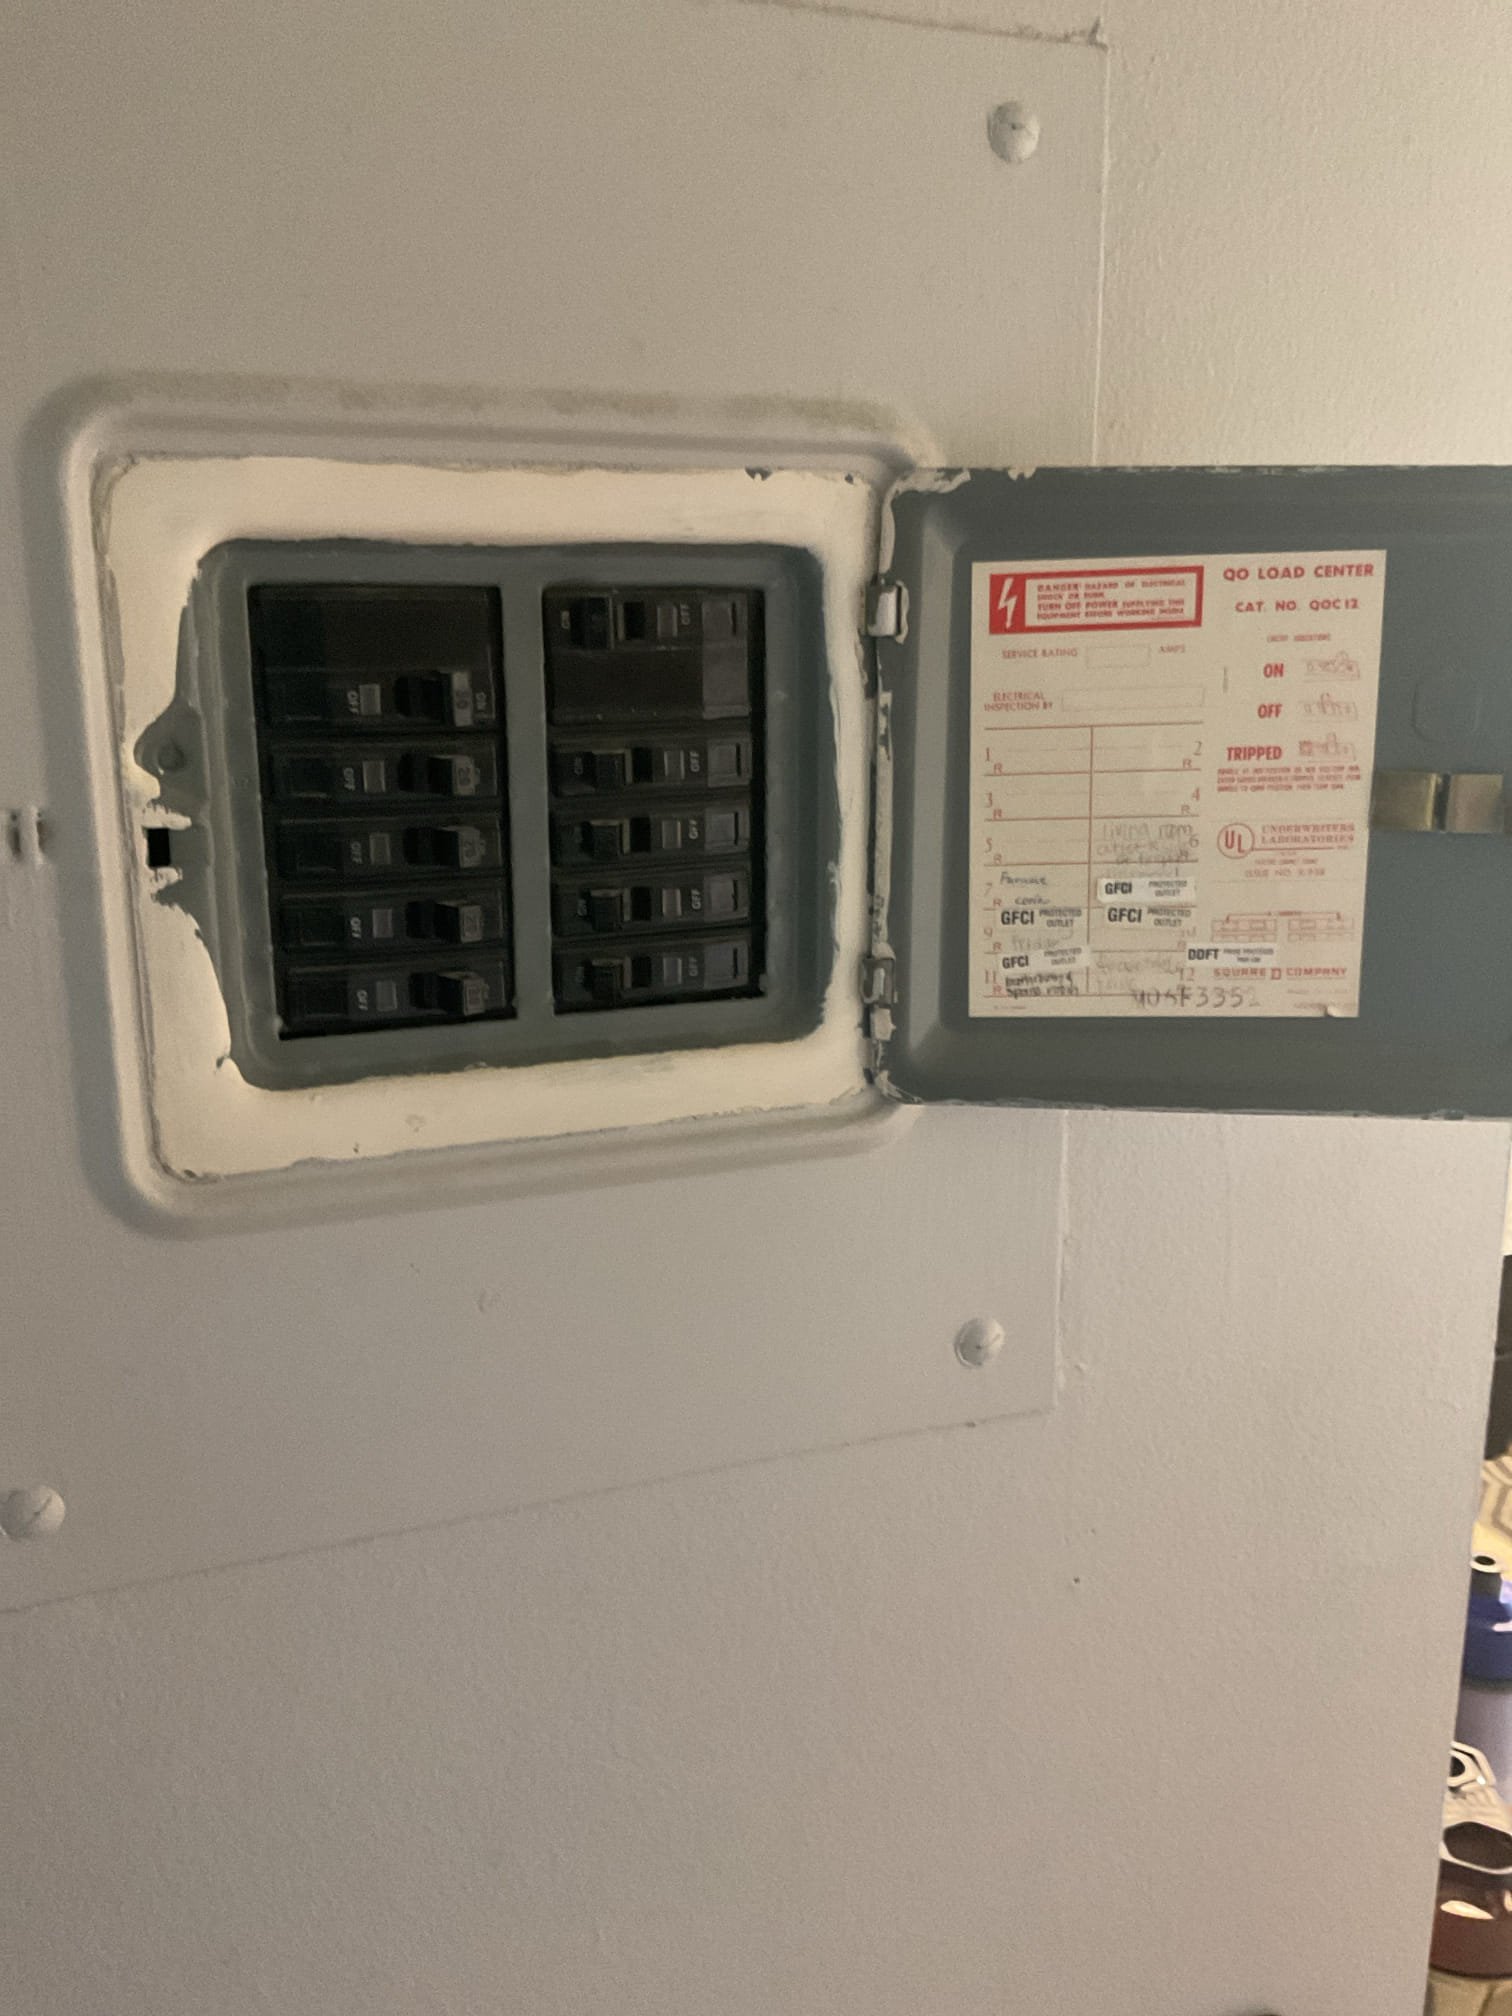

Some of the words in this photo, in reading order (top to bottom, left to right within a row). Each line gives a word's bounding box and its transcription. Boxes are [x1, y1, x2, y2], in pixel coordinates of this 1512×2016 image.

[1223, 566, 1250, 582] QO
[1257, 565, 1305, 580] LOAD
[1313, 563, 1374, 578] CENTER
[1263, 662, 1285, 679] ON
[1257, 702, 1283, 719] OFF
[1226, 746, 1283, 762] TRIPPED
[689, 751, 701, 774] OFF
[1191, 787, 1200, 801] 4
[1262, 822, 1355, 834] UNDERWRITERS
[1188, 832, 1200, 849] 6
[1261, 834, 1355, 845] LABORATORIES
[1104, 881, 1133, 895] GFCI
[691, 888, 703, 912] OFF
[1001, 909, 1035, 926] GFCI
[1046, 918, 1074, 928] OUTLET
[1107, 907, 1143, 923] GFCI
[1002, 954, 1030, 970] GFCI
[1213, 967, 1267, 979] SQUARE
[1271, 967, 1282, 981] D
[1287, 966, 1347, 979] COMPANY
